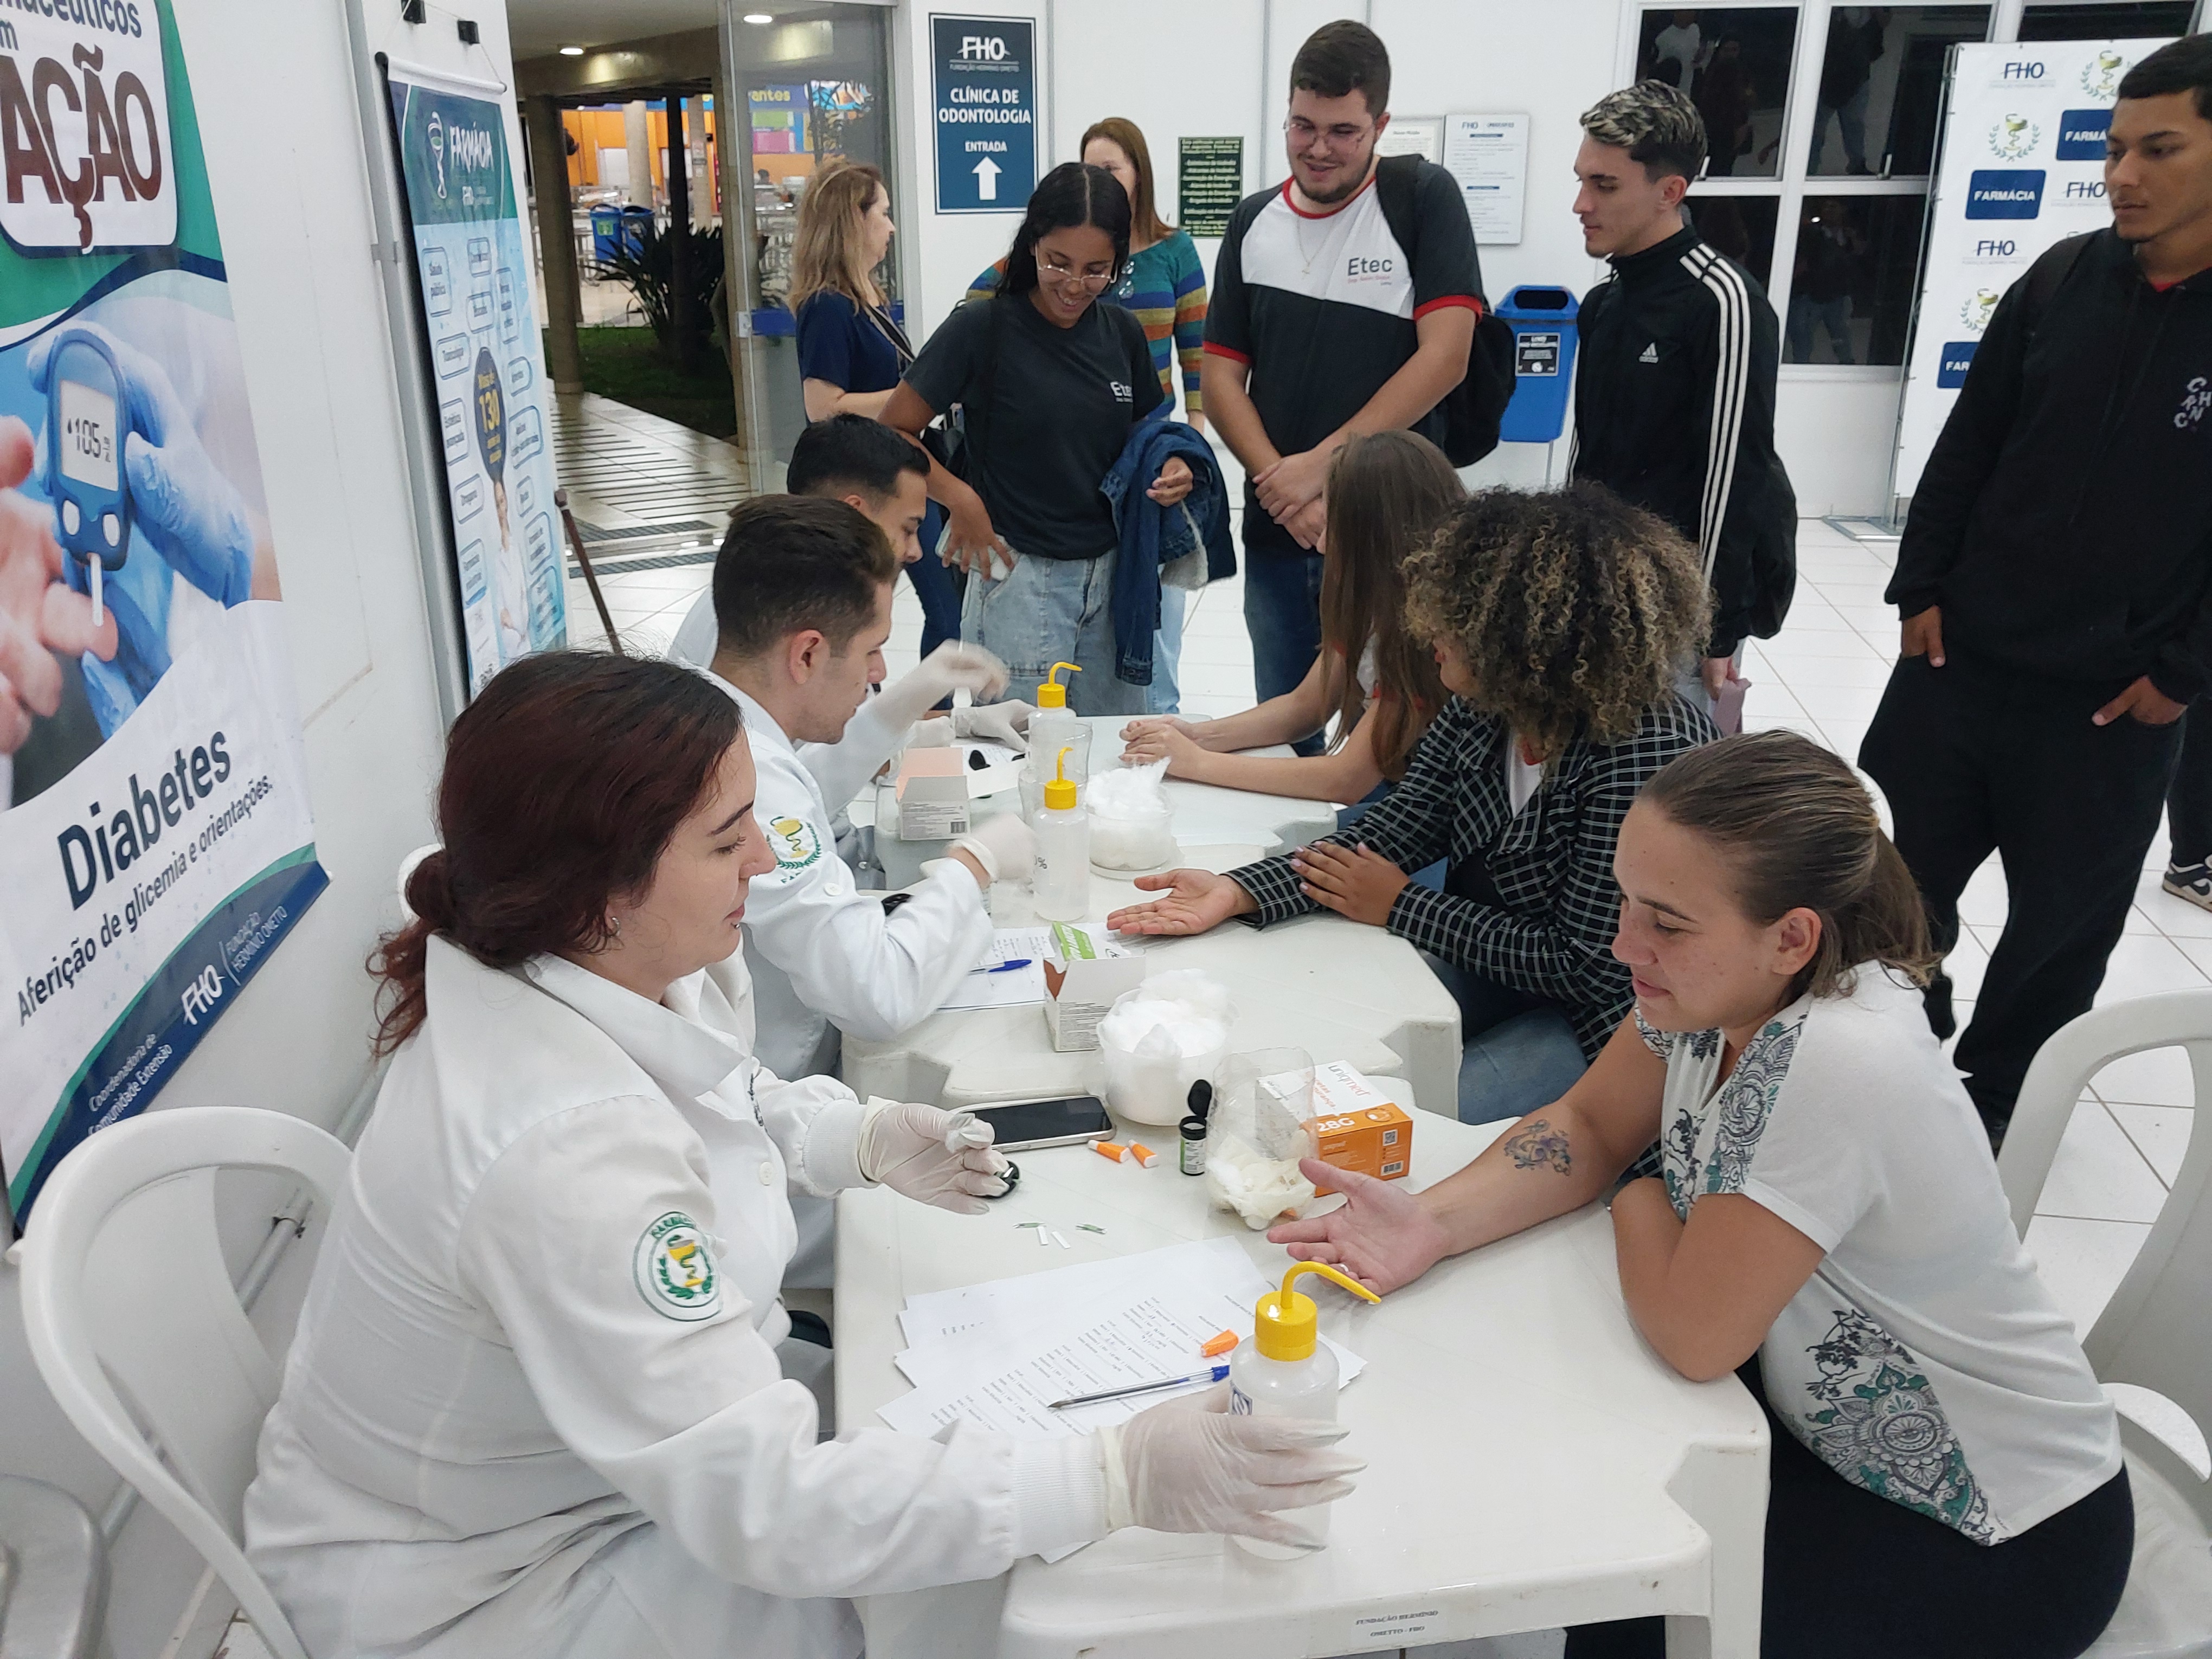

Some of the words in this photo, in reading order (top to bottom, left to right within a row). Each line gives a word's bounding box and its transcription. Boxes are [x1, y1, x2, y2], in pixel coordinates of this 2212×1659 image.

[960, 36, 1007, 60] FHO
[2003, 61, 2044, 79] FHO
[950, 85, 1000, 104] CLÍNICA
[1002, 88, 1020, 104] DE
[938, 107, 1032, 124] ODONTOLOGIA
[0, 42, 162, 248] AÇÃO
[2065, 129, 2107, 142] FARMÁ
[964, 140, 1008, 152] ENTRADA
[1973, 188, 2036, 201] FARMÁCIA
[2066, 181, 2106, 198] FHO
[1977, 240, 2015, 256] FHO
[1347, 257, 1393, 276] Etec
[75, 418, 101, 459] 105
[56, 731, 231, 911] Diabetes
[16, 937, 97, 1027] Aferição
[100, 913, 123, 948] de
[125, 851, 188, 933] glicemia
[189, 841, 197, 864] e
[181, 964, 223, 1026] FHO
[135, 1044, 173, 1085] Extensão
[1317, 1117, 1355, 1132] 28G
